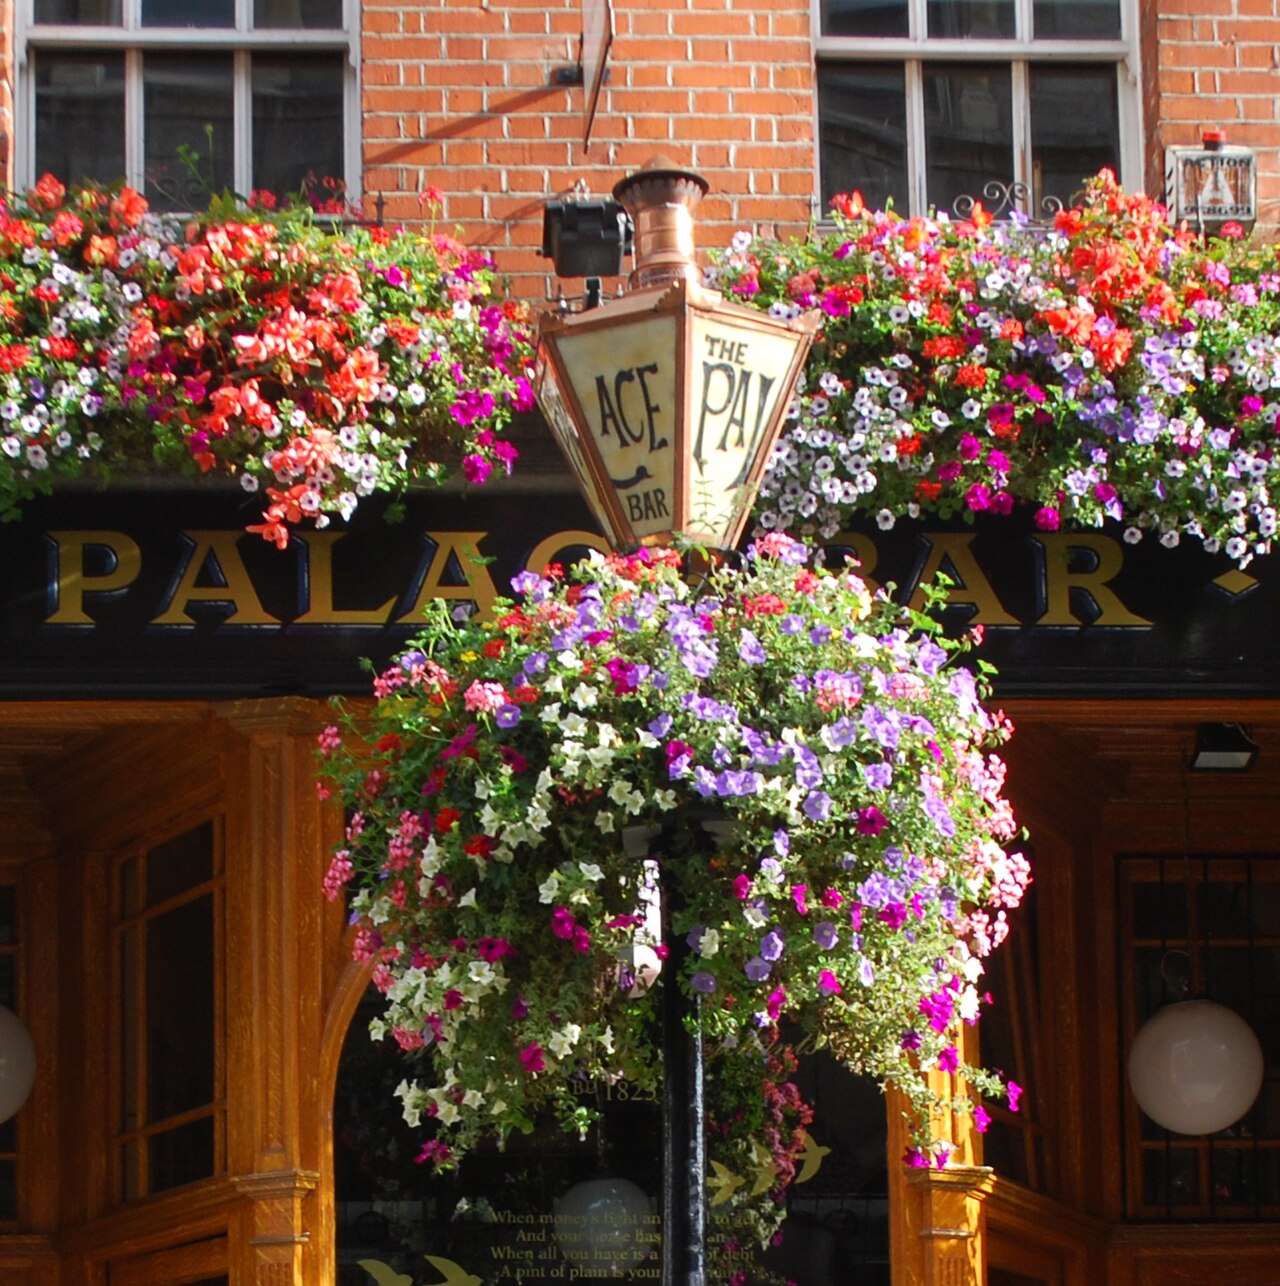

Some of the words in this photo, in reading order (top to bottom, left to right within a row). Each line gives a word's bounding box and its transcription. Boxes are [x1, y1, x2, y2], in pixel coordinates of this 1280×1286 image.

[706, 335, 748, 365] THE
[595, 363, 668, 454] ACE
[627, 488, 671, 523] BAR
[43, 528, 610, 628] PALA
[492, 1210, 534, 1224] When
[516, 1229, 546, 1242] And
[490, 1247, 533, 1260] When
[539, 1246, 557, 1260] all
[562, 1251, 589, 1264] you
[594, 1247, 628, 1260] have
[633, 1248, 645, 1260] is
[500, 1265, 511, 1277] A
[517, 1265, 545, 1281] pint
[550, 1264, 566, 1278] of
[570, 1264, 607, 1281] plain
